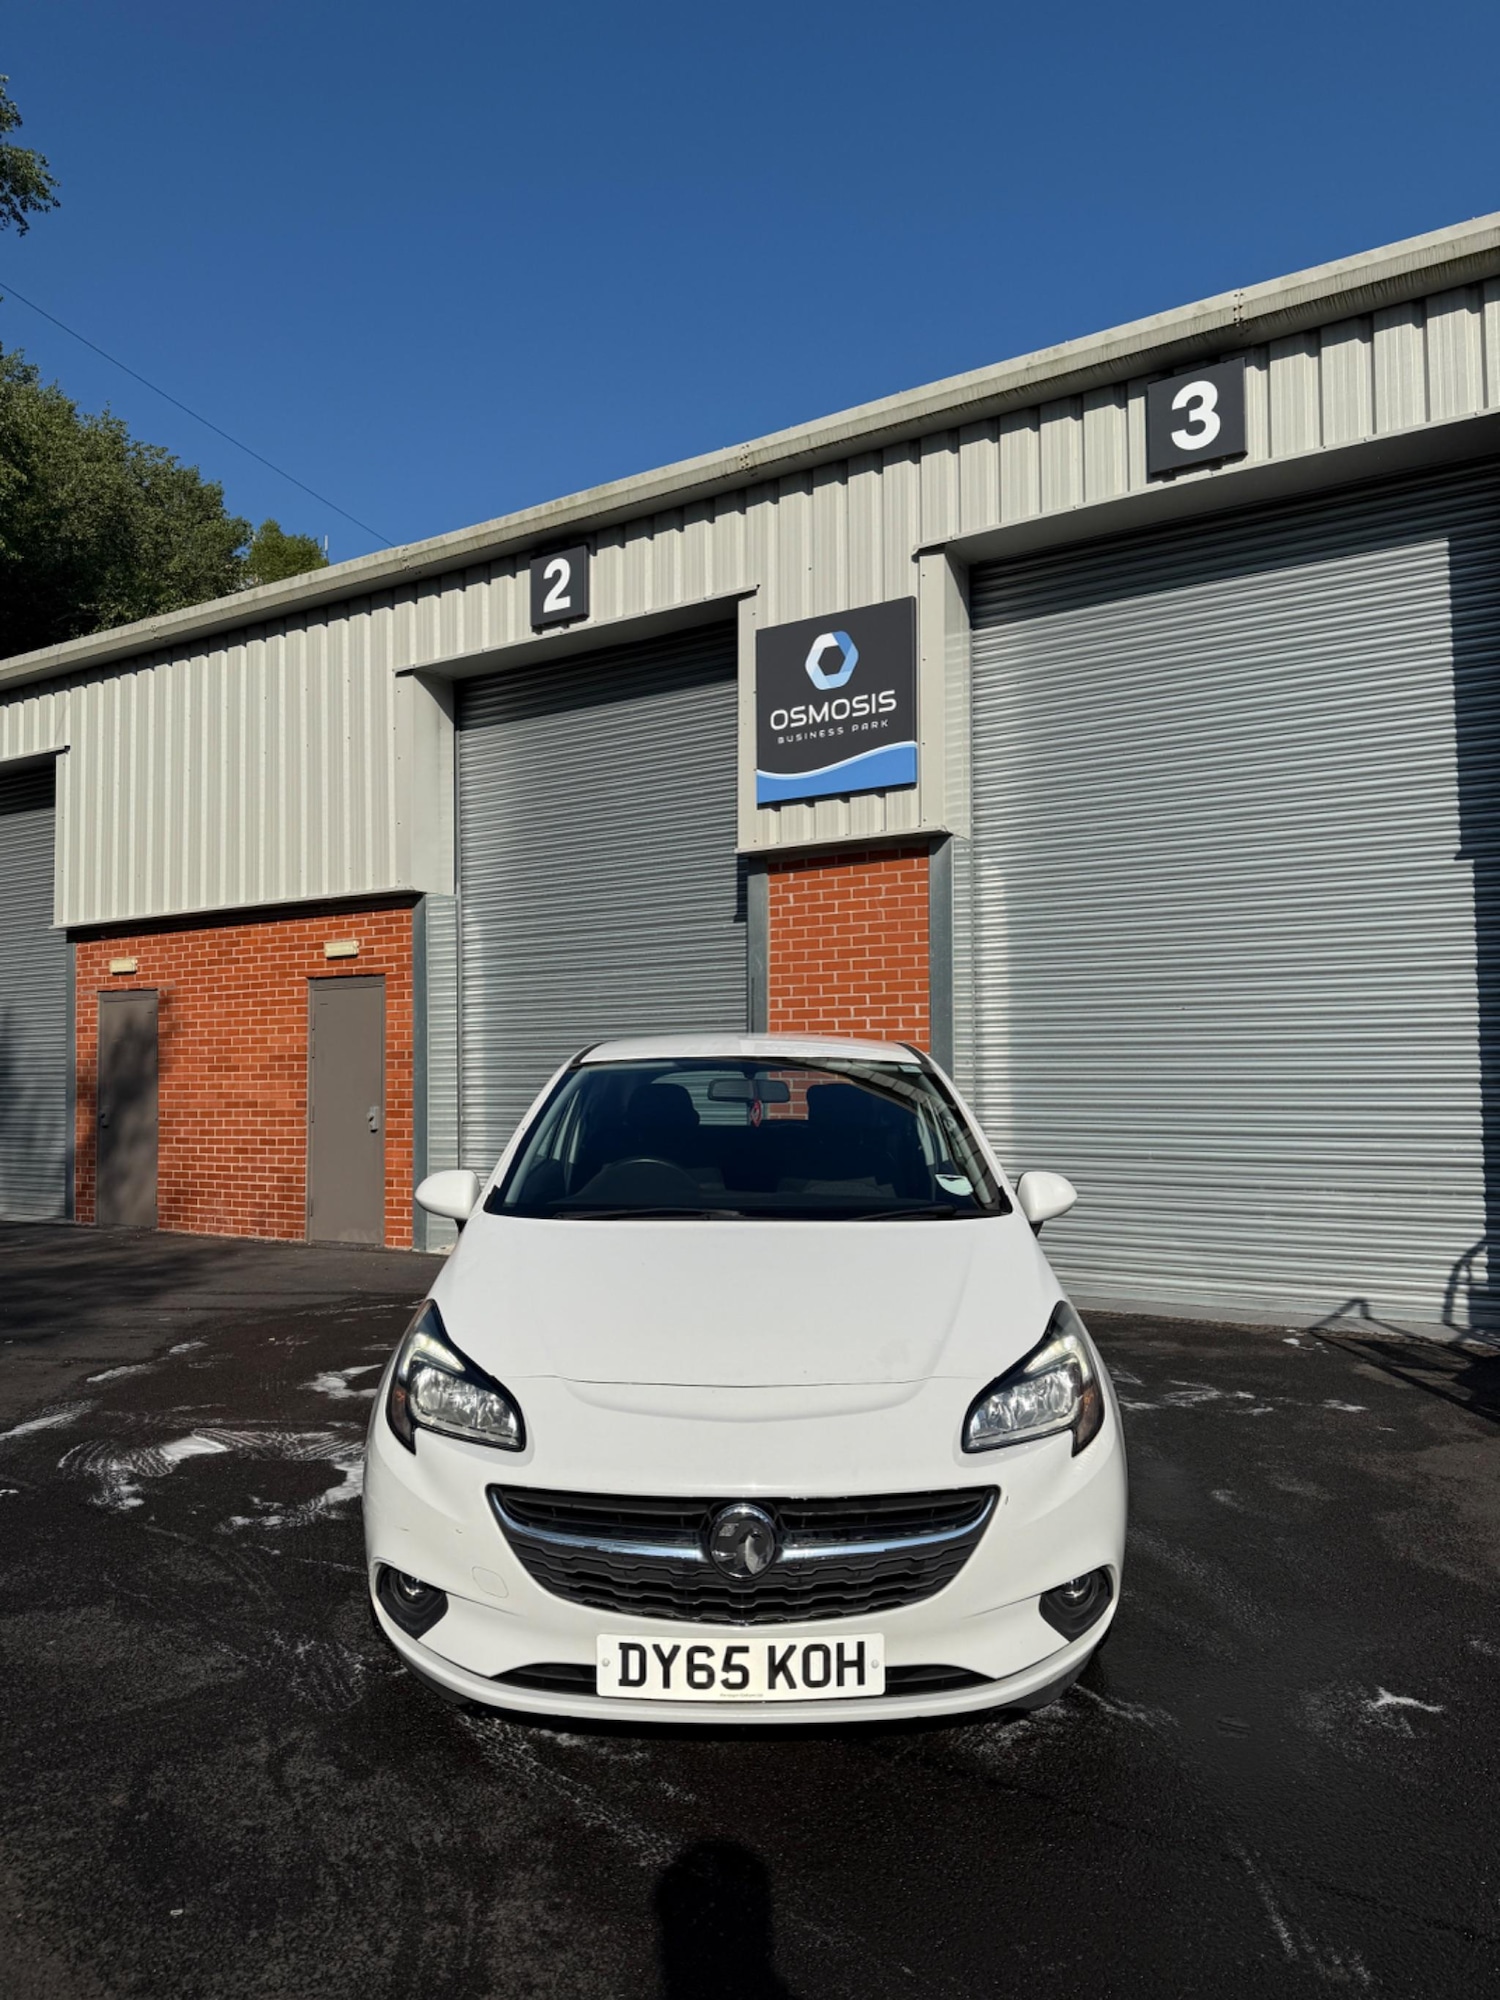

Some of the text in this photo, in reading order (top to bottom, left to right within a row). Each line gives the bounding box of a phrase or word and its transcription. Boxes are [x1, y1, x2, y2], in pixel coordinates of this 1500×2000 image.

[1171, 380, 1221, 451] 3
[543, 557, 571, 614] 2
[769, 689, 897, 731] OSMOSIS
[777, 718, 889, 745] BUSINESS PARK
[617, 1641, 866, 1690] DY65 KOH
